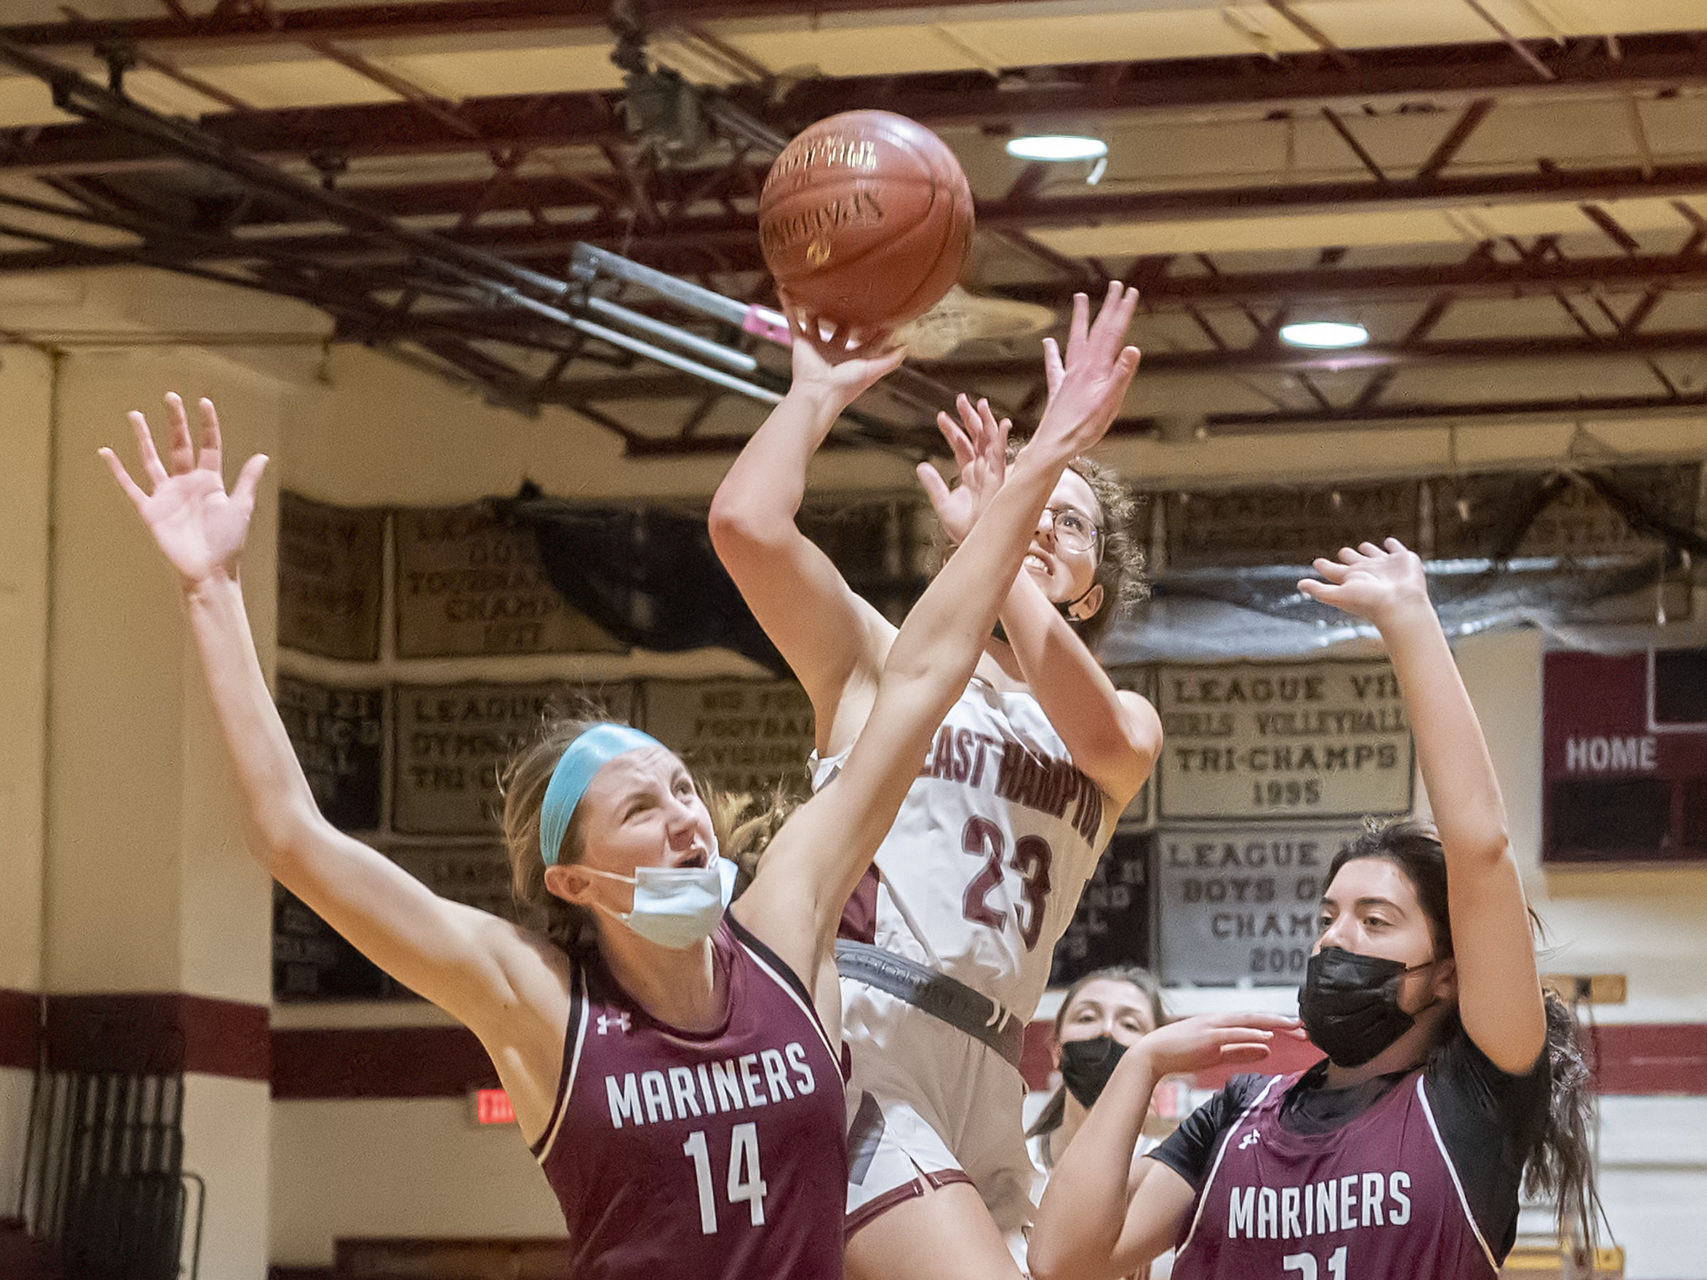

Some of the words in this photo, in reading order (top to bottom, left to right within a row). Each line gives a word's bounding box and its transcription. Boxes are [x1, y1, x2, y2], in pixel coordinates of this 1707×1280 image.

[1174, 677, 1325, 703] LEAGUE
[919, 724, 995, 789] AST
[1566, 735, 1657, 772] HOME
[961, 813, 1052, 953] 23
[1167, 841, 1320, 868] LEAGUE
[1183, 875, 1276, 902] BOYS
[605, 1041, 816, 1129] MARINERS
[683, 1121, 768, 1235] 14
[1228, 1170, 1412, 1240] MARINERS
